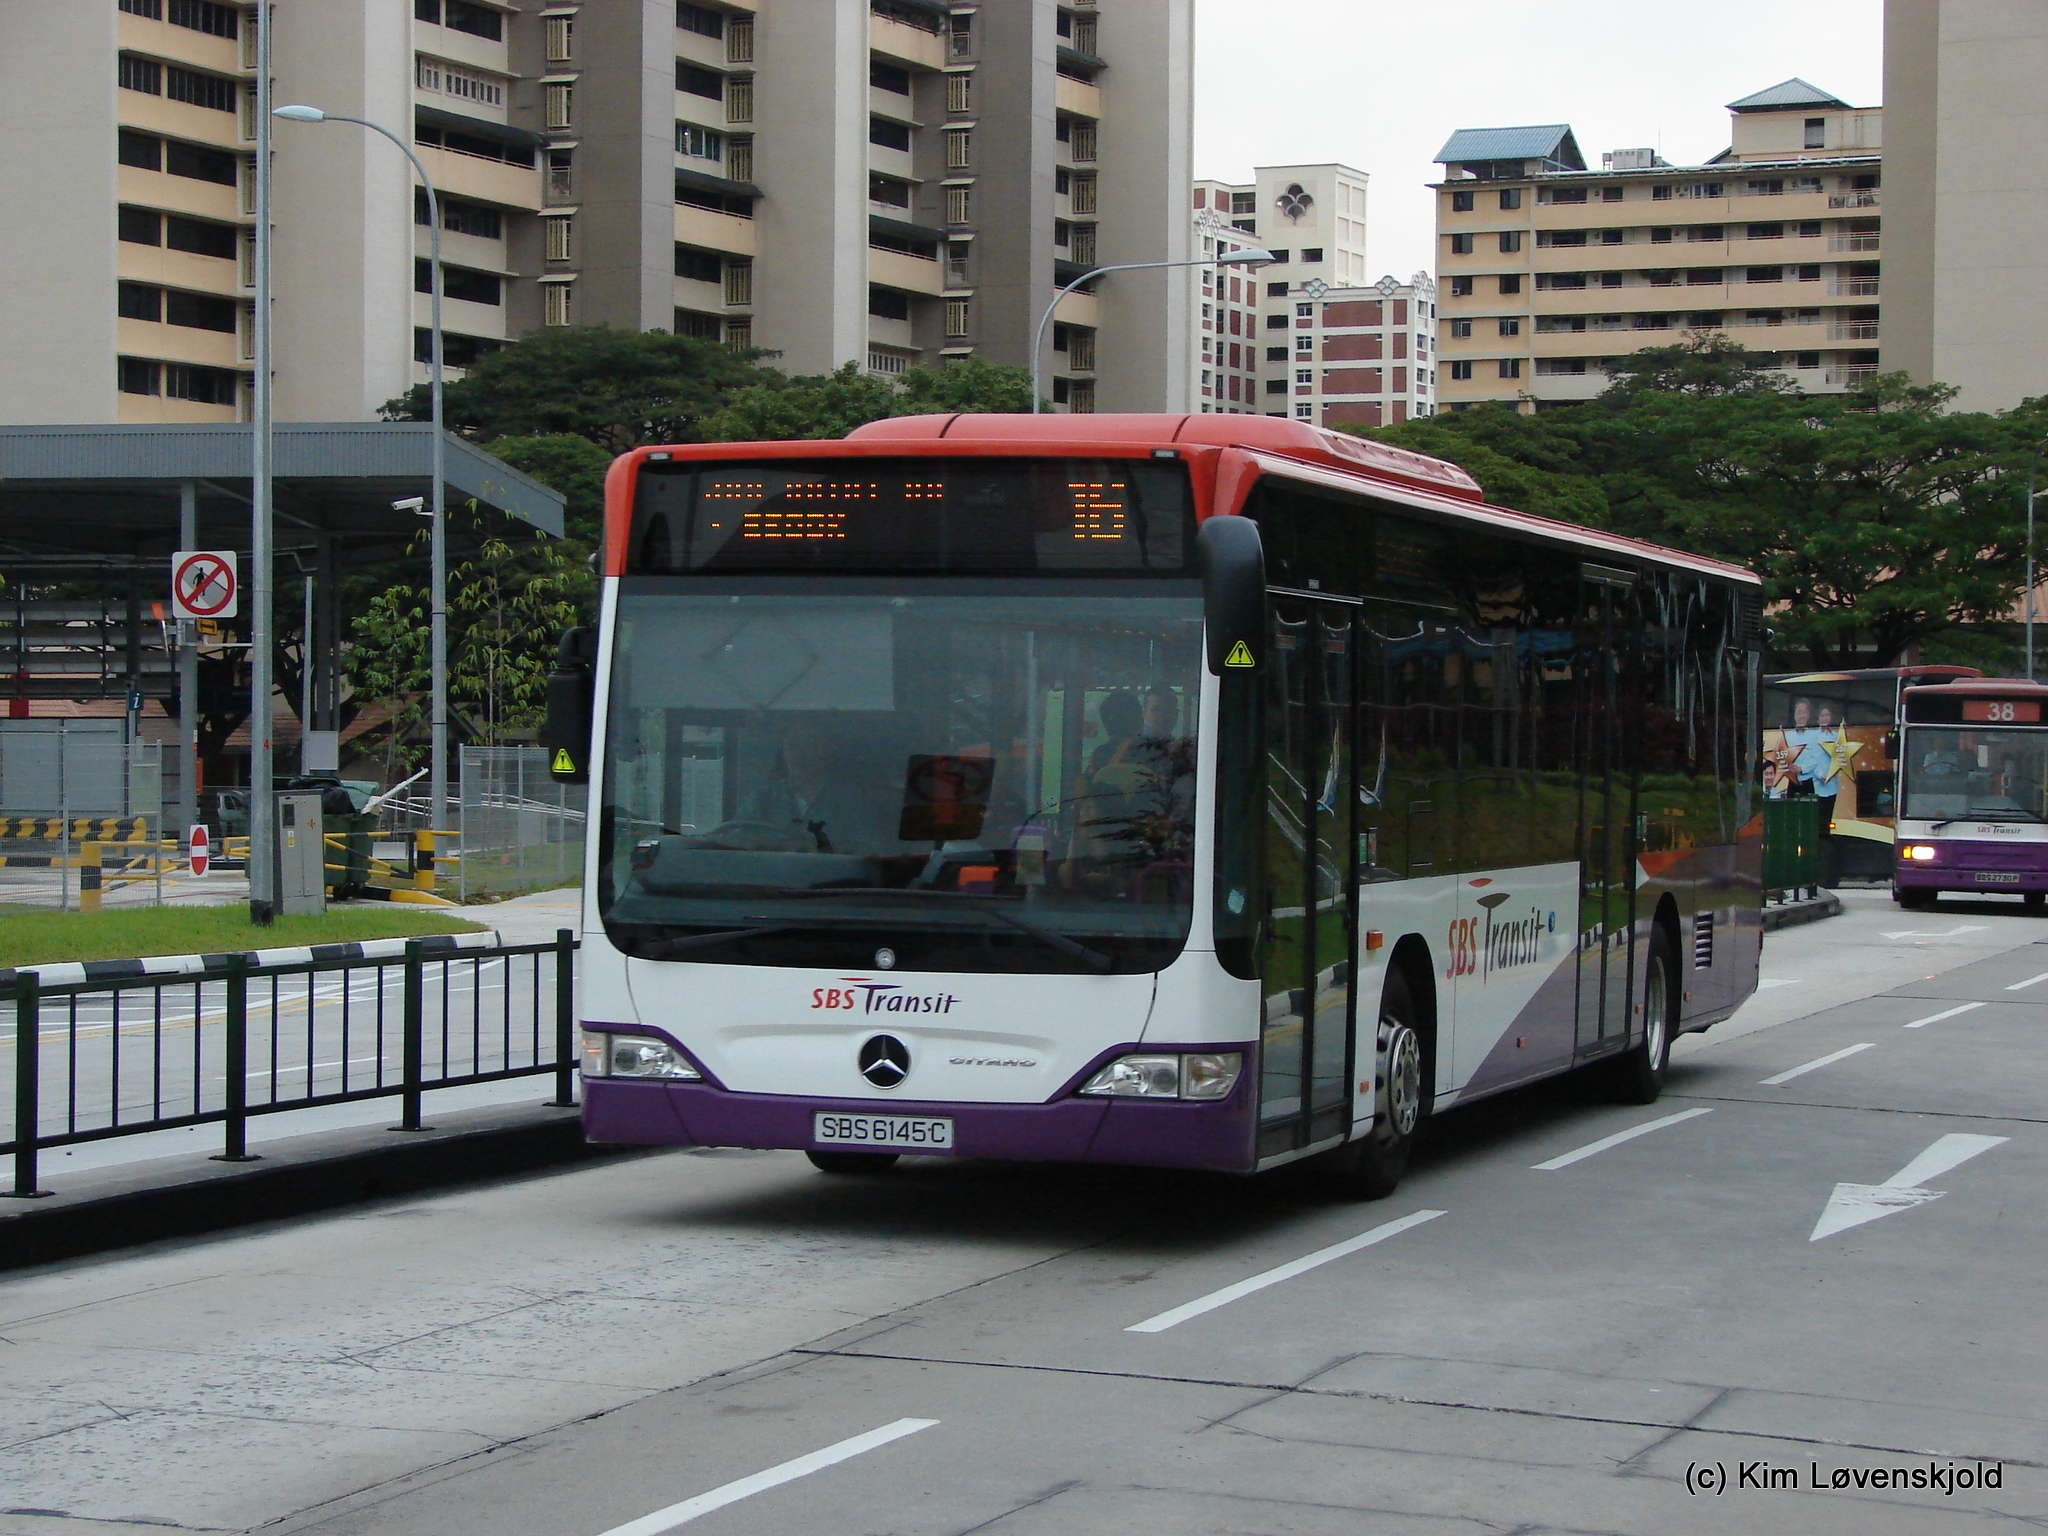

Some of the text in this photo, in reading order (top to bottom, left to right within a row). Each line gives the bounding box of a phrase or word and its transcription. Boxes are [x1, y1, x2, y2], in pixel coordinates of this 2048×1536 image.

[1986, 702, 2015, 722] 38
[1992, 825, 2023, 834] Transit
[1446, 892, 1546, 985] SBS Transit
[811, 984, 963, 1015] SBS Transit
[821, 1116, 946, 1144] SBS6145C
